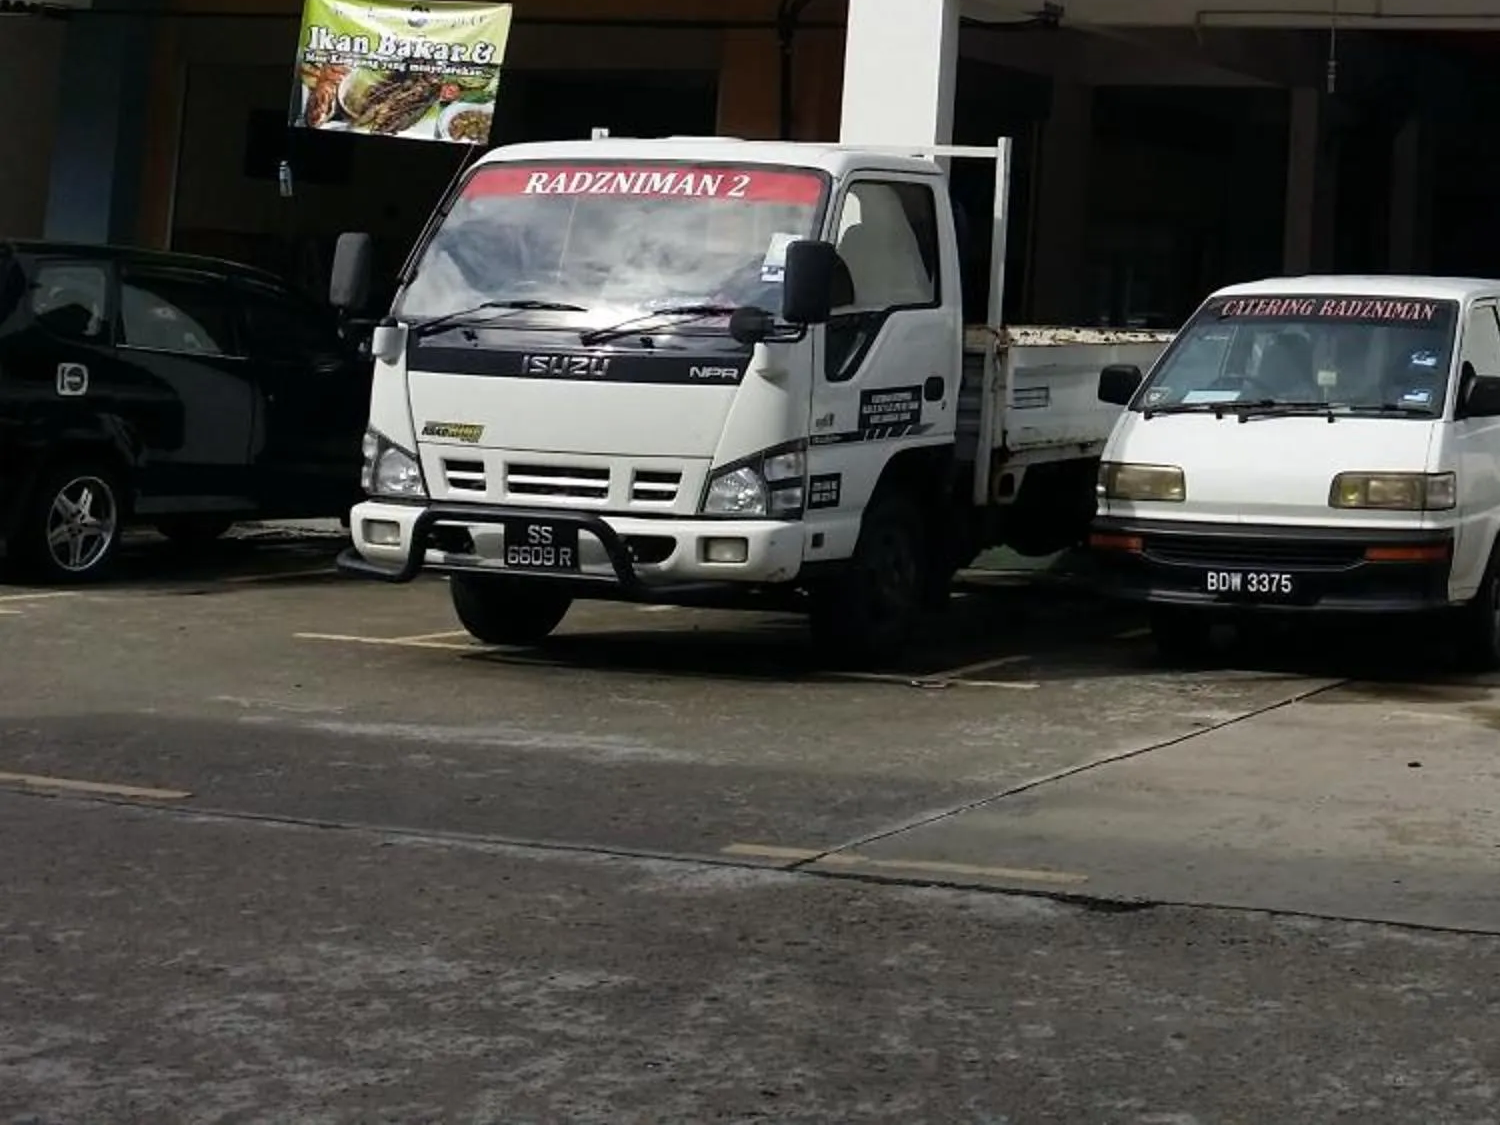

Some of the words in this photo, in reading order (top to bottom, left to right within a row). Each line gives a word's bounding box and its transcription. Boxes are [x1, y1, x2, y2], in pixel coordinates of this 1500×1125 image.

[309, 26, 370, 54] Ikan
[377, 32, 468, 62] Bakar
[471, 40, 496, 65] &
[523, 171, 724, 197] RADZNIMAN
[727, 174, 751, 198] 2
[1221, 298, 1316, 317] CATERING
[1318, 299, 1437, 321] RADZNIMAN
[521, 354, 611, 376] ISUZU
[689, 366, 739, 380] NPR
[527, 524, 554, 545] SS
[559, 547, 572, 568] R
[1207, 571, 1242, 592] BDW
[1247, 572, 1293, 594] 3375
